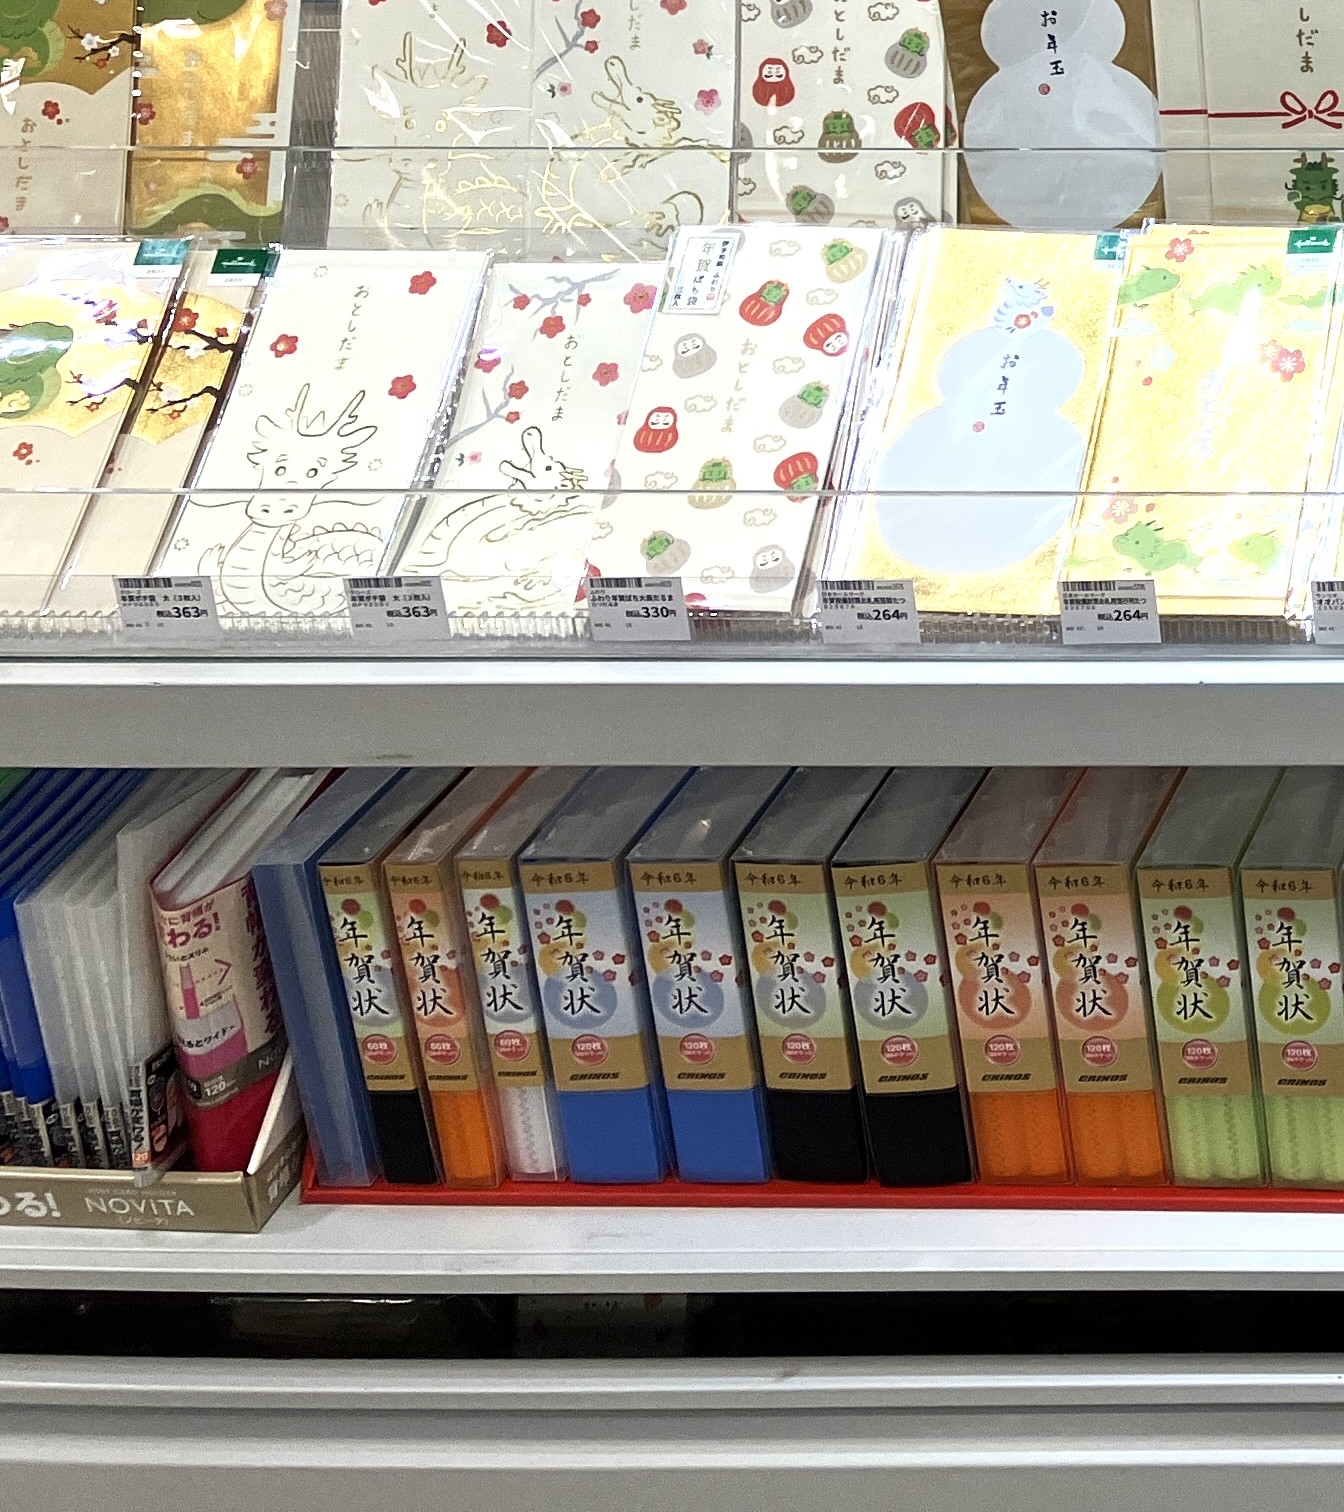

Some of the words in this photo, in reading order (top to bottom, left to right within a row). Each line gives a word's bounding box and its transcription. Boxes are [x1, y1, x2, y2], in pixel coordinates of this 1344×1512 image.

[1040, 9, 1066, 77] お年玉
[335, 283, 371, 372] おとしだま
[950, 873, 1007, 888] 令和6年
[553, 913, 600, 1016] 年賀状
[969, 916, 1015, 1017] 年賀状
[84, 1196, 196, 1218] NOVITA
